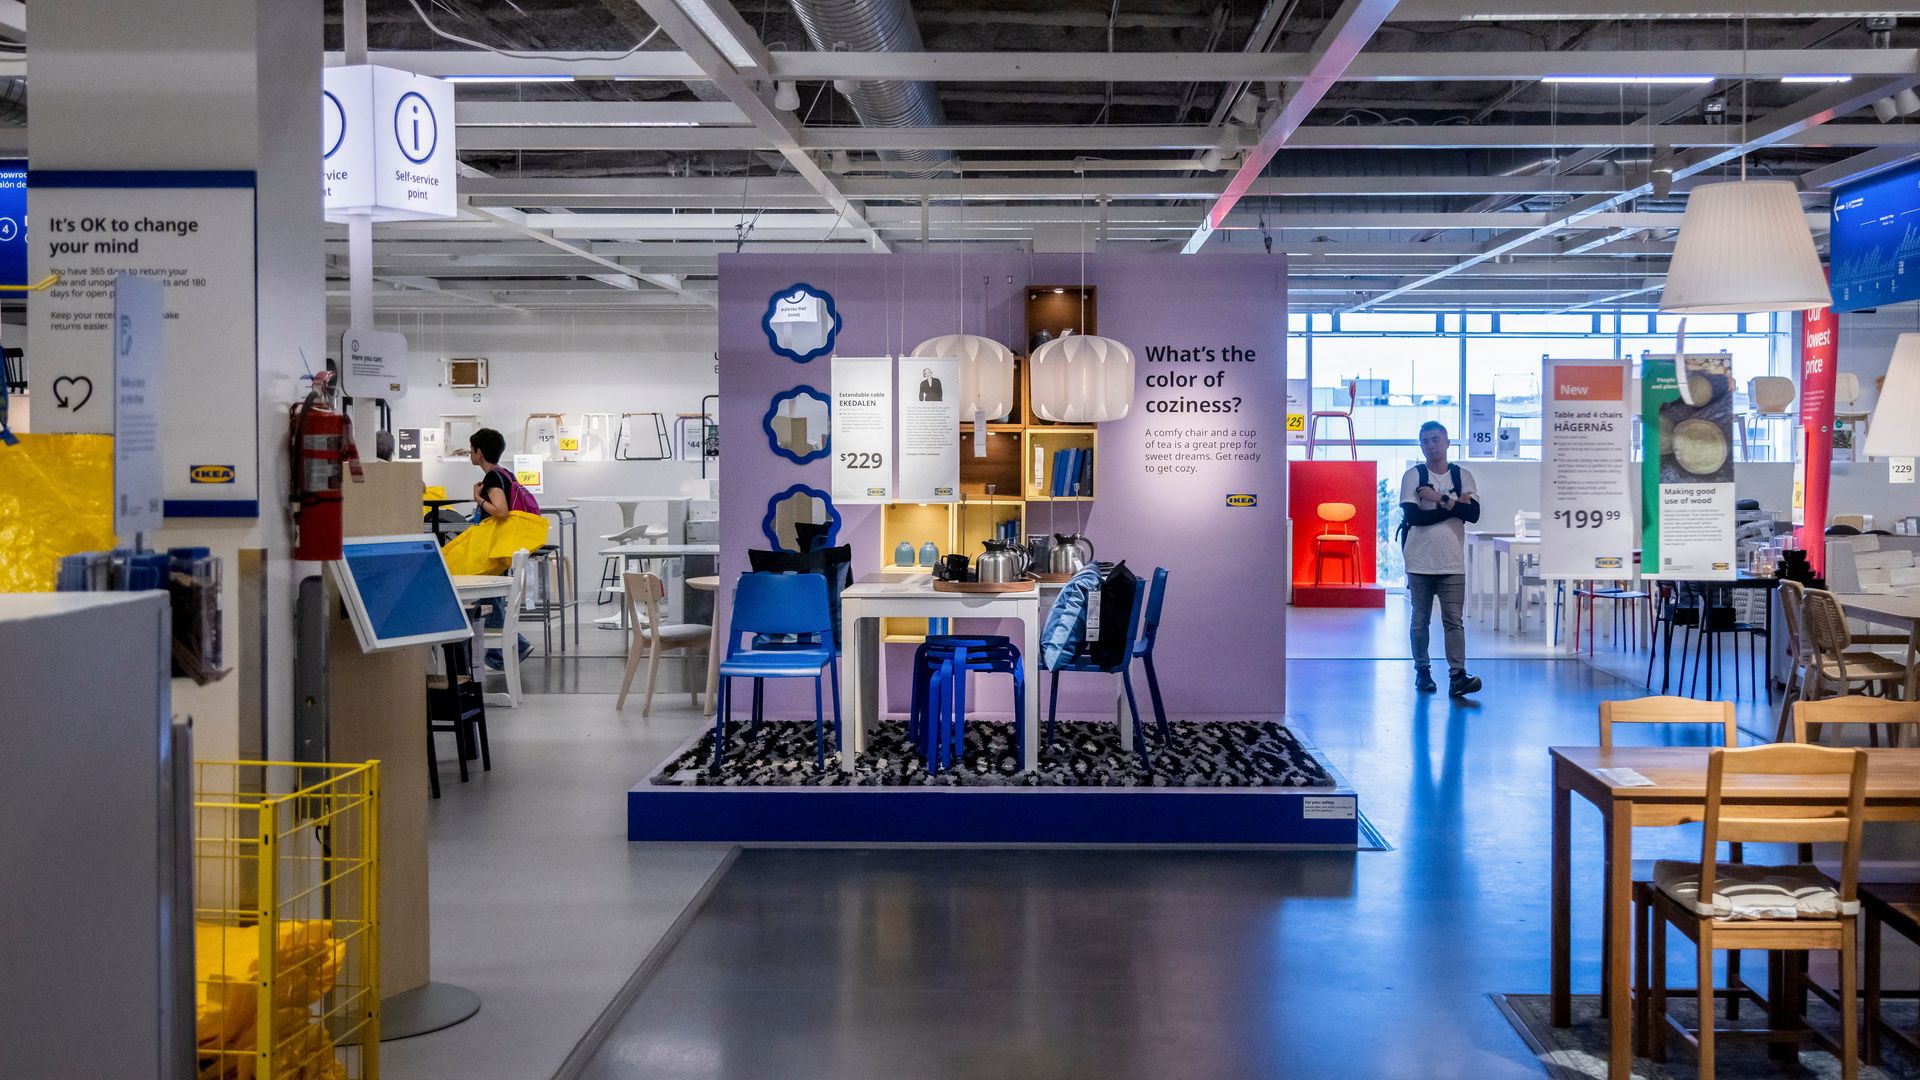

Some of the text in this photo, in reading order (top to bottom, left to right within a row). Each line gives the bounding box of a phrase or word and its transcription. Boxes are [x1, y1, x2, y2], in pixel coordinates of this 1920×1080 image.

[396, 170, 439, 186] Self-service
[408, 189, 428, 200] point
[2, 224, 9, 234] 4
[50, 218, 198, 236] It's OK to change
[50, 239, 138, 257] your mind
[68, 267, 88, 275] have
[90, 267, 105, 275] 365
[168, 269, 188, 278] your
[88, 280, 116, 288] unope
[50, 289, 70, 299] days
[71, 288, 83, 297] for
[86, 290, 108, 299] open
[51, 312, 72, 320] Keep
[73, 312, 92, 321] your
[1806, 328, 1830, 348] lowest
[1146, 346, 1256, 362] What's the
[1806, 356, 1823, 380] price
[1146, 371, 1225, 387] color of
[1560, 385, 1589, 395] New
[1146, 397, 1242, 413] coziness?
[1154, 428, 1182, 439] comfy
[1185, 428, 1208, 437] chair
[1211, 428, 1228, 437] and
[1239, 431, 1256, 439] cup
[1473, 432, 1491, 442] $85
[1145, 440, 1154, 449] of
[1192, 441, 1217, 451] great
[1220, 442, 1241, 451] prep
[1244, 440, 1257, 449] for
[840, 453, 883, 469] $229
[1175, 452, 1213, 460] dreams.
[1235, 452, 1260, 462] ready
[1158, 465, 1172, 474] get
[1175, 466, 1198, 474] cozy.
[1554, 510, 1603, 528] $199
